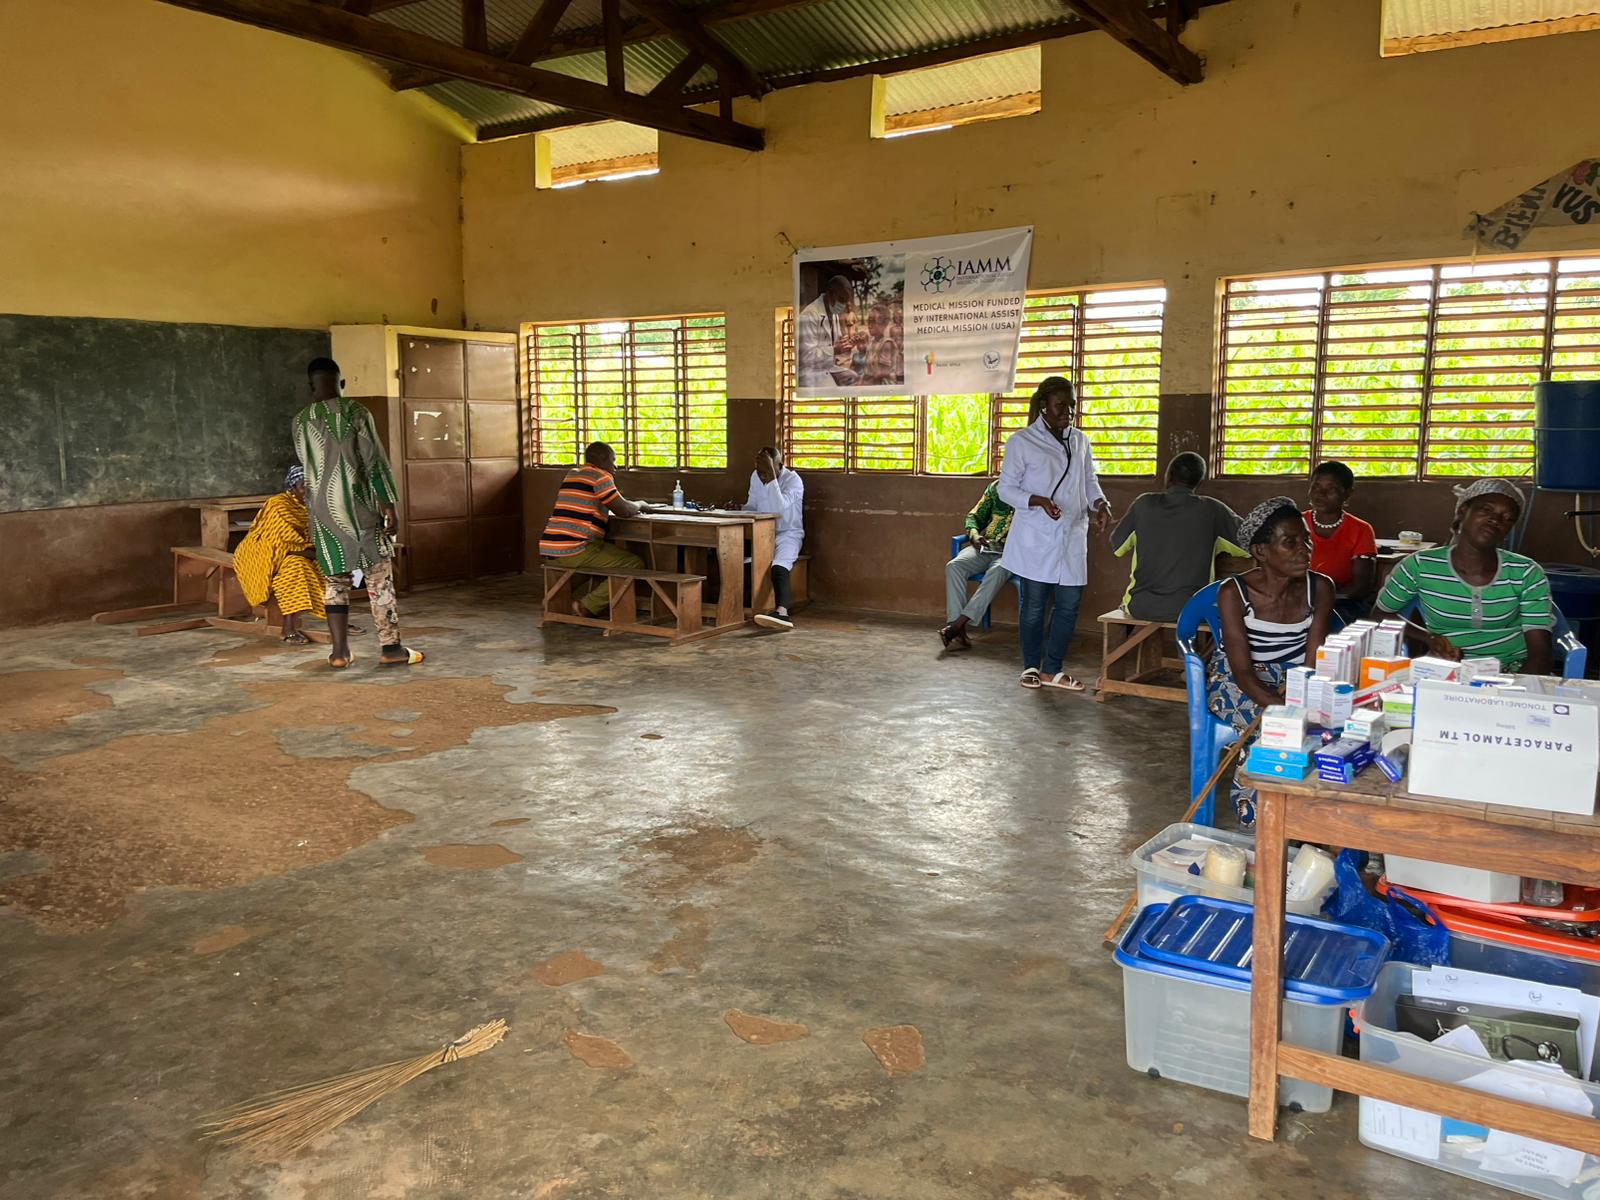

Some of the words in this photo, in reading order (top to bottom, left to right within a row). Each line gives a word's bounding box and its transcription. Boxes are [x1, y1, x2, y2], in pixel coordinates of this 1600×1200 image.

[957, 256, 1011, 275] IAMM
[913, 302, 946, 311] MEDICAL
[948, 299, 984, 309] MISSION
[986, 297, 1020, 307] FUNDED
[913, 315, 924, 323] BY
[926, 312, 988, 322] INTERNATIONAL
[990, 309, 1019, 319] ASSIST
[917, 326, 950, 335] MEDICAL
[952, 323, 988, 332] MISSION
[991, 321, 1015, 331] (USA)
[1443, 694, 1505, 706] LABORATOIRE
[1505, 700, 1547, 711] TONGMEI
[1439, 729, 1459, 740] TM
[1463, 732, 1573, 752] PARACETAMOL
